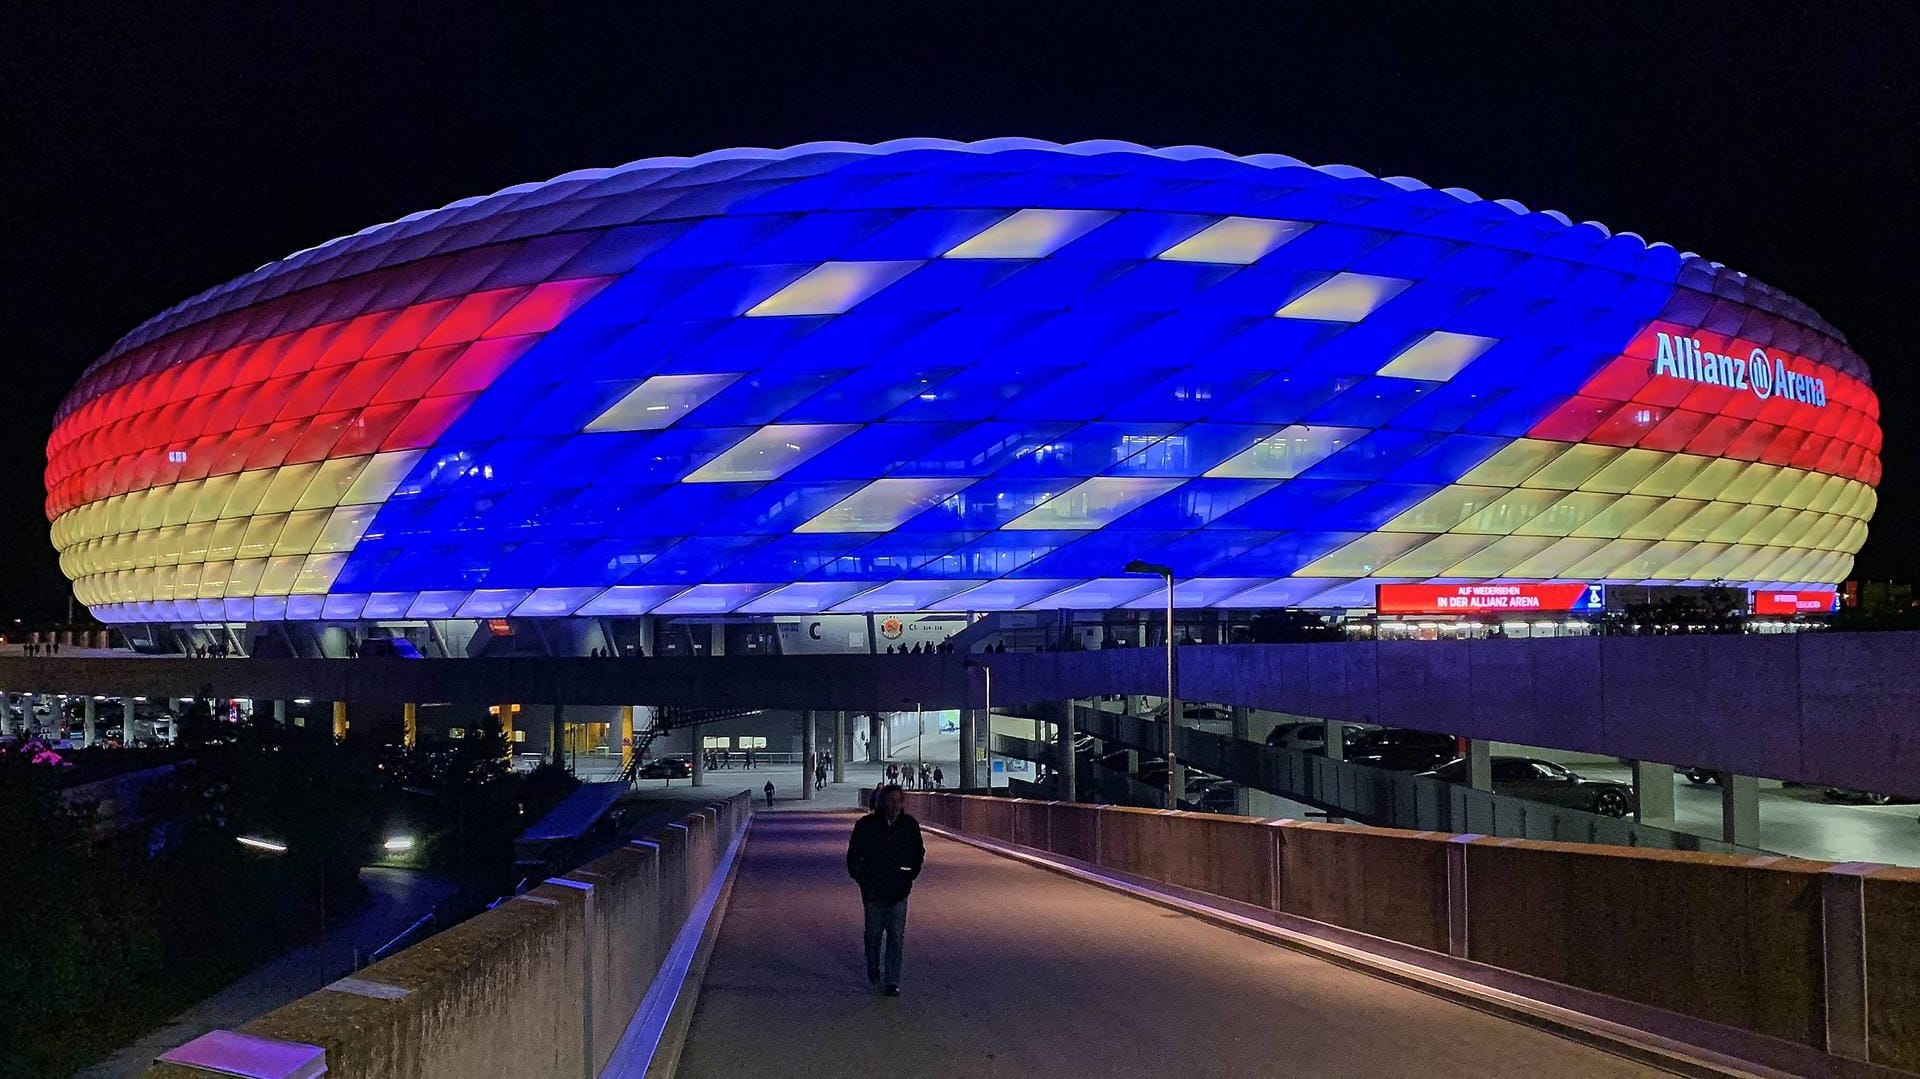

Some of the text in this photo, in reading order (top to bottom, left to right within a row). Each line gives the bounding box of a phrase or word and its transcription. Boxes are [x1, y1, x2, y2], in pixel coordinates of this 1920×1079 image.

[1656, 332, 1826, 407] Allianz Arena
[1458, 587, 1520, 595] AUF WIEDERSEHEN
[1437, 597, 1540, 607] IN DER ALLIANZ ARENA
[809, 622, 821, 640] C
